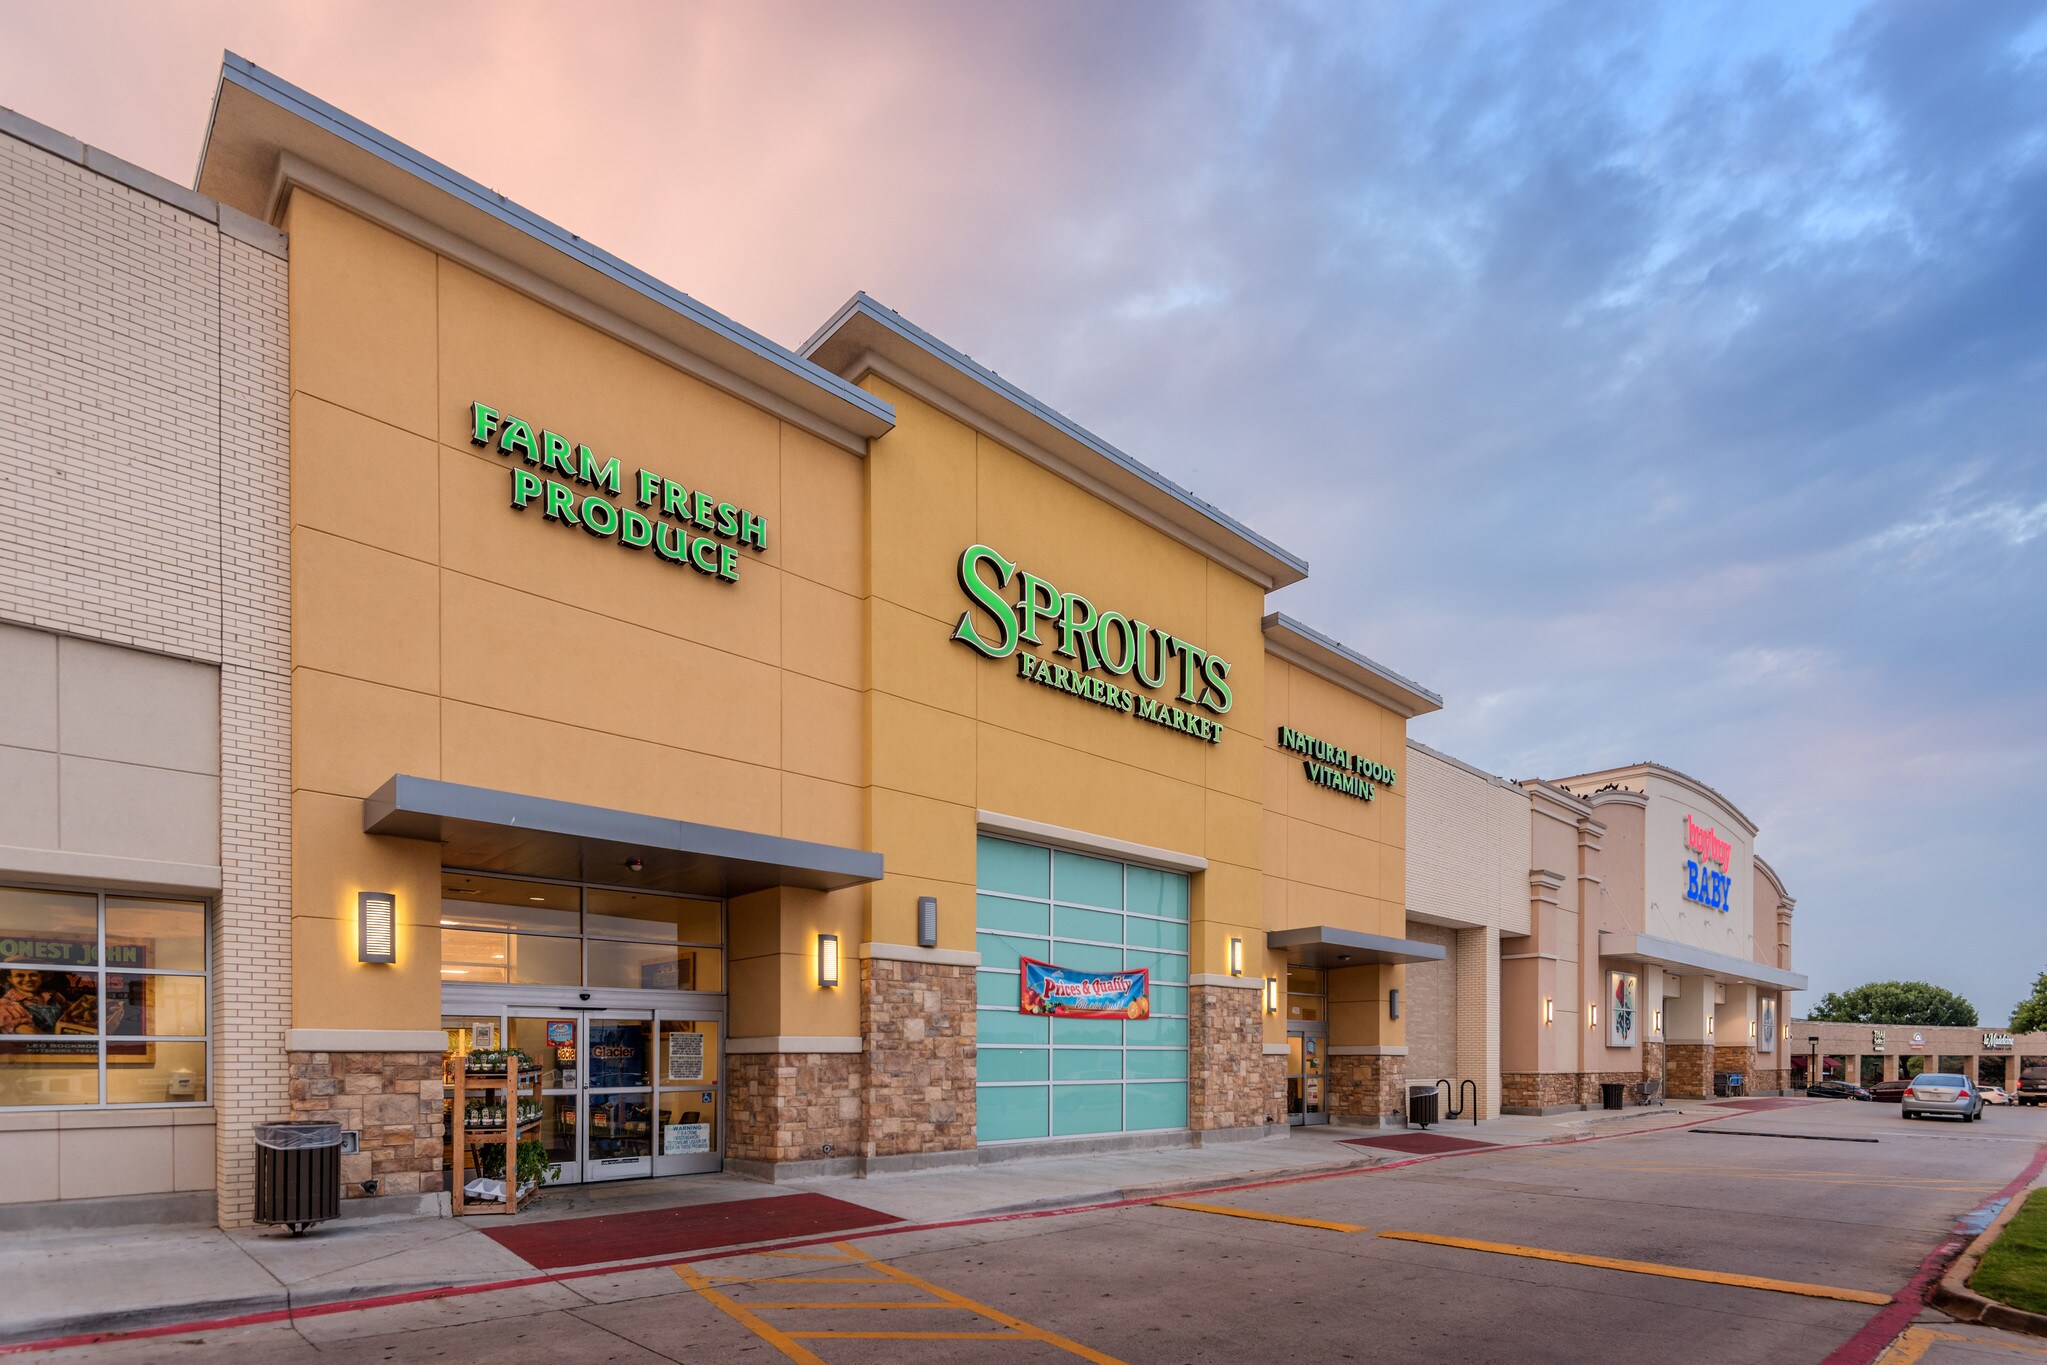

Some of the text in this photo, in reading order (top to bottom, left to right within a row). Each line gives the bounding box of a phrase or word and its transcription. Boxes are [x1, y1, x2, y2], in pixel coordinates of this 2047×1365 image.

[471, 401, 768, 551] FARM FRESH
[511, 467, 740, 583] PRODUCE
[951, 544, 1232, 714] SPROUTS
[1018, 651, 1224, 744] FARMERS MARKET
[1279, 726, 1397, 786] NATURAL FOODS
[1304, 761, 1376, 802] VITAMINS
[1686, 859, 1732, 913] BABY
[1043, 975, 1133, 999] Prices & Quality
[592, 1045, 635, 1058] Glacier
